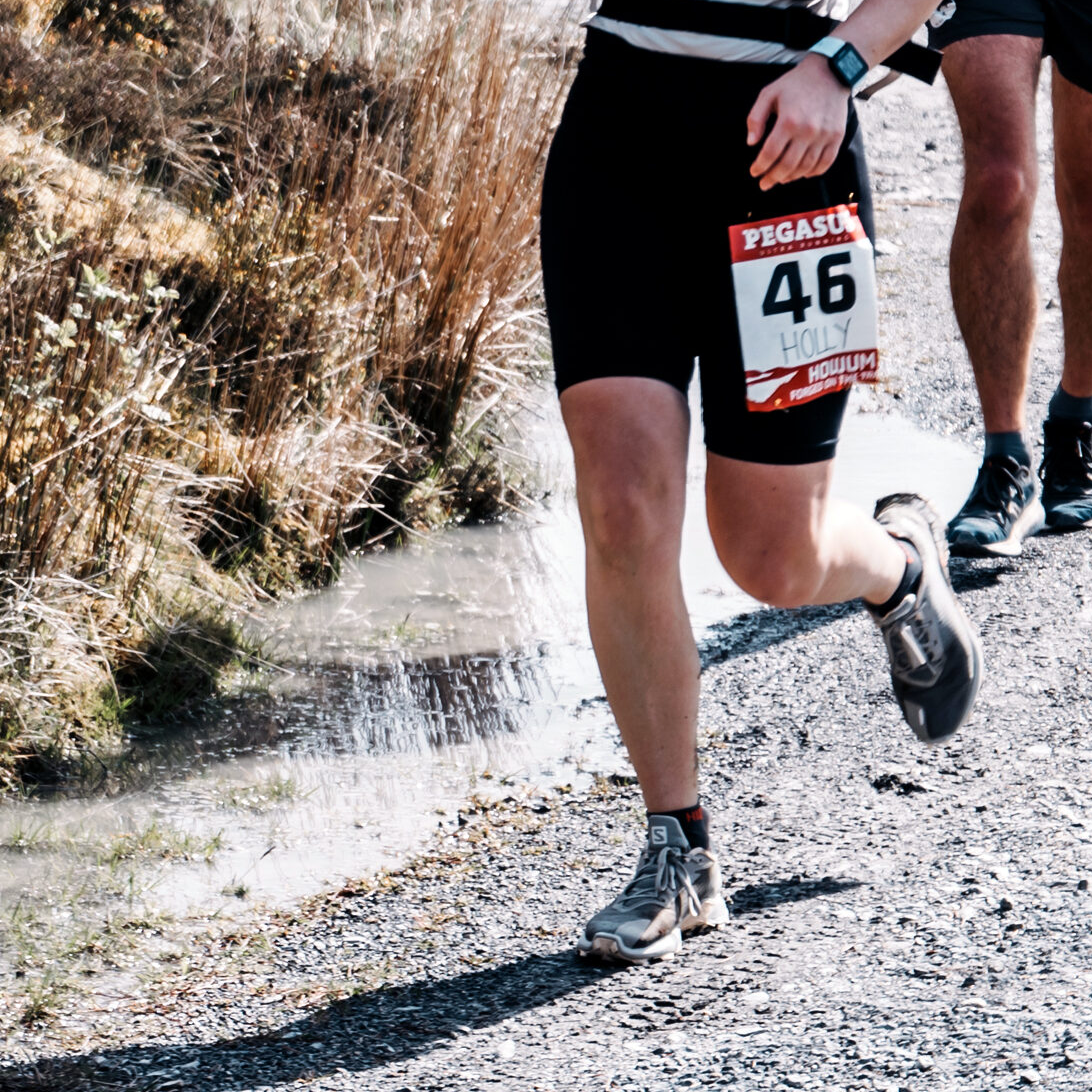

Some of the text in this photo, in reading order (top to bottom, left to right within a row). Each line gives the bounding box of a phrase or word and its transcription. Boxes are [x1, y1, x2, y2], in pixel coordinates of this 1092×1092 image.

[762, 250, 856, 324] 46
[780, 318, 851, 364] HOLLY
[808, 352, 876, 384] HOWUM
